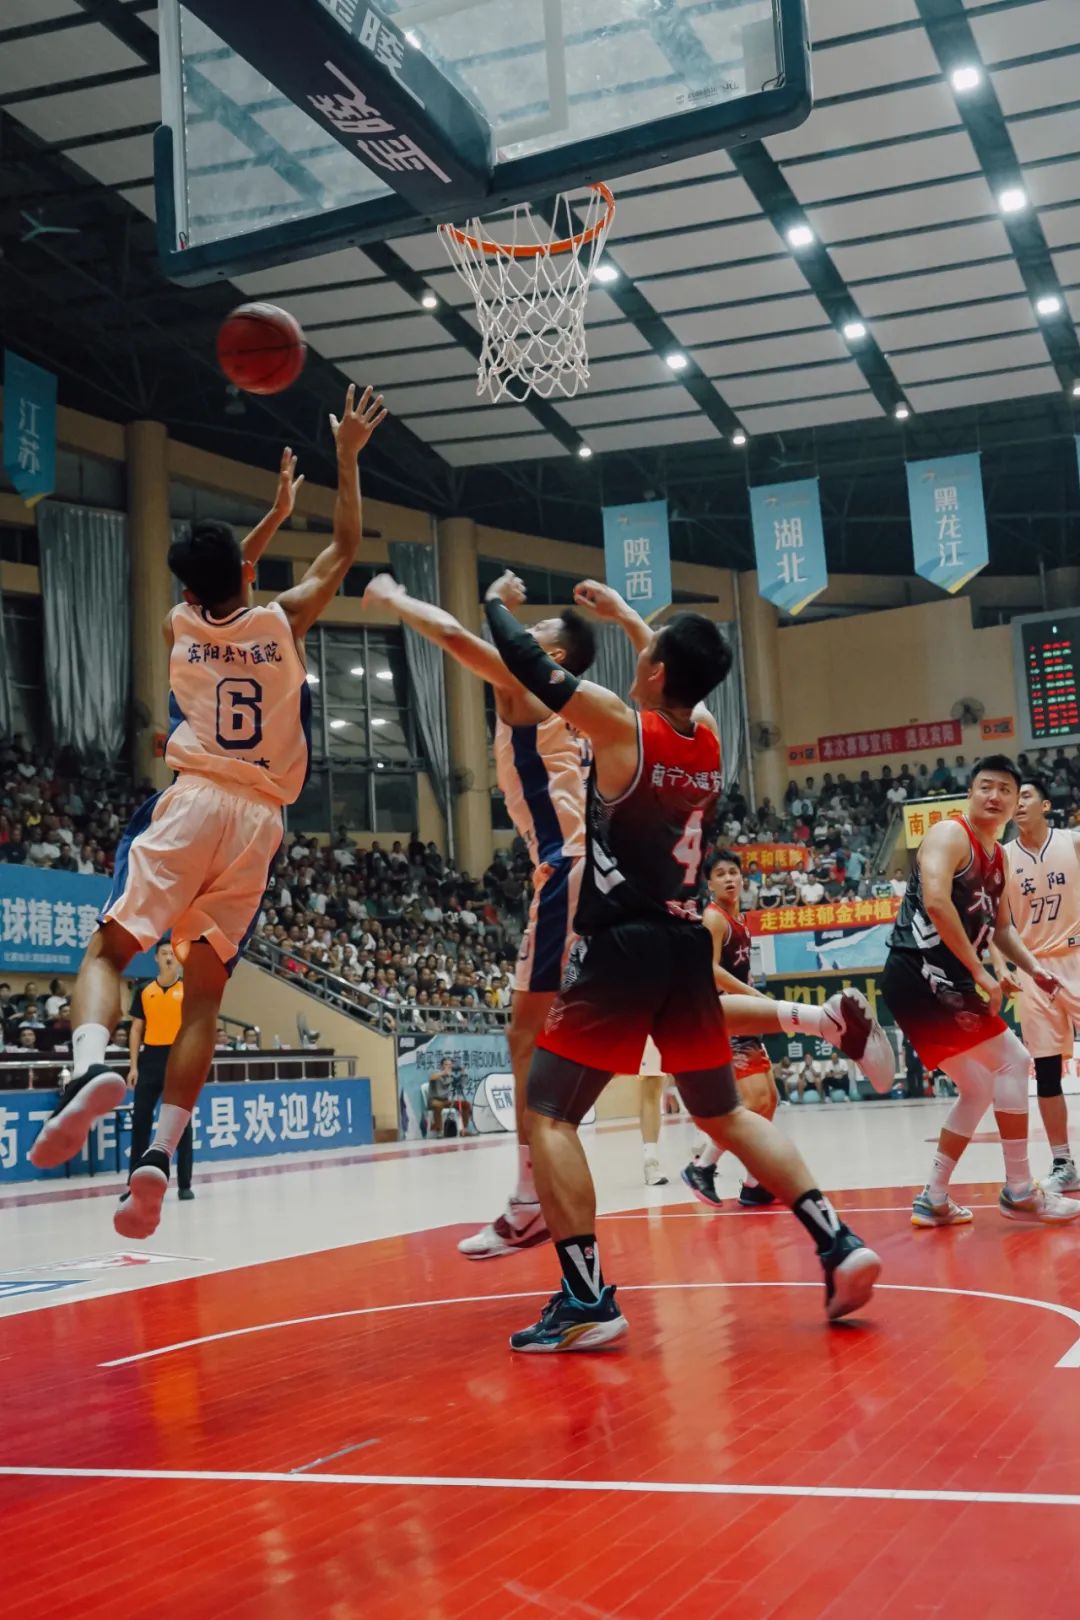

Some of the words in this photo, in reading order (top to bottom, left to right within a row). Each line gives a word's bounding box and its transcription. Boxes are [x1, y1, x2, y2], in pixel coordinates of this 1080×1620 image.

[18, 397, 40, 475] 江苏
[773, 517, 807, 584] 湖北
[933, 486, 965, 568] 黑龙江
[622, 537, 654, 601] 陕西
[216, 677, 263, 750] 6
[671, 807, 705, 887] 4
[760, 899, 902, 932] 走进桂郁金种植
[1030, 894, 1062, 925] 77
